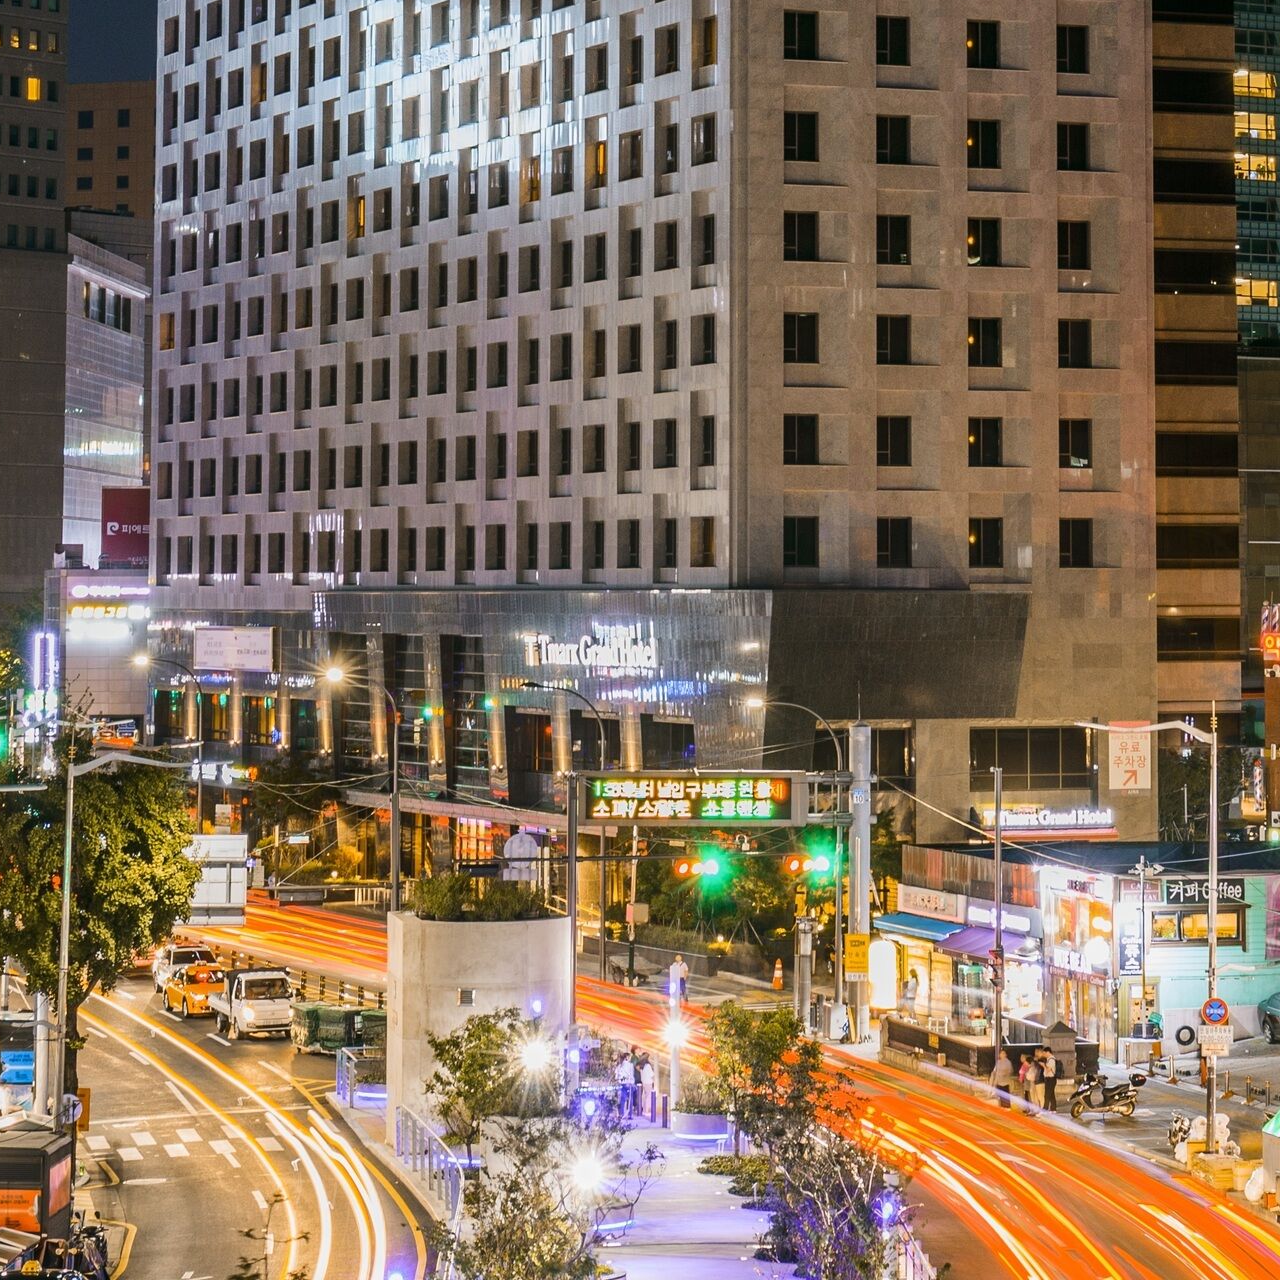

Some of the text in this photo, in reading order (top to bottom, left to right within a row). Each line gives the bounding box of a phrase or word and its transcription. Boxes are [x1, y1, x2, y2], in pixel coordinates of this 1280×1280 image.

[1119, 741, 1141, 755] 유료
[1113, 756, 1147, 769] 주차장
[1168, 880, 1242, 903] 커피 Cffee
